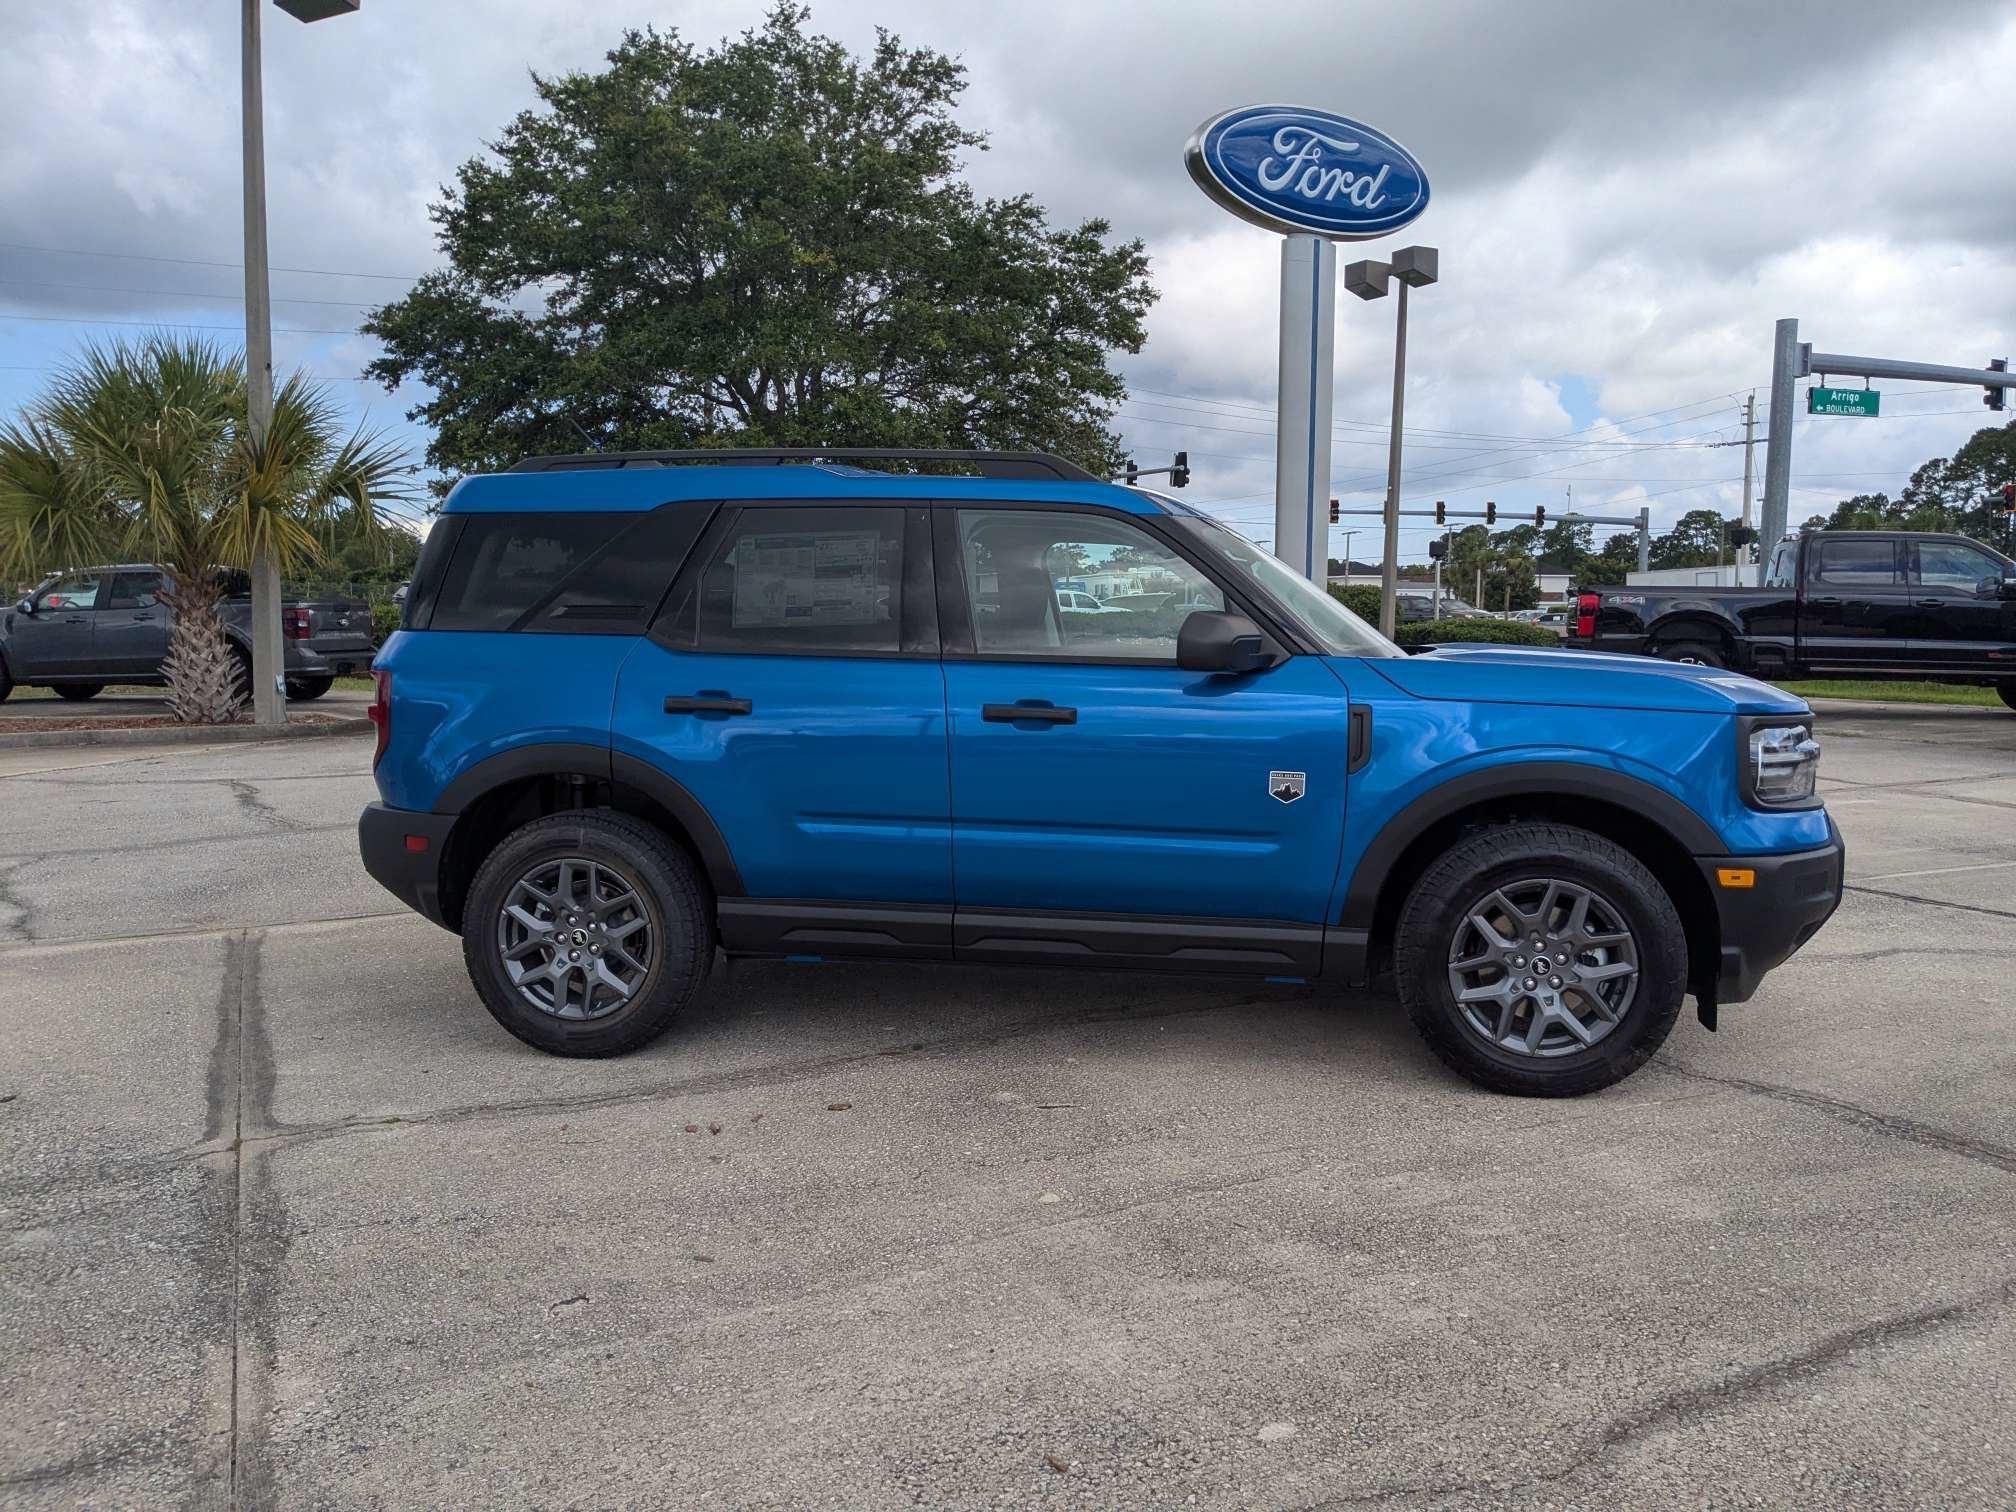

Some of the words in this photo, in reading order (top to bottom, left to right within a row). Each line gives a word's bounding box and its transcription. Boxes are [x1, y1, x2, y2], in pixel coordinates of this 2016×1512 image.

[1258, 126, 1390, 210] Ford
[1831, 391, 1860, 405] Arrigo
[1826, 404, 1865, 414] BOULEVARD
